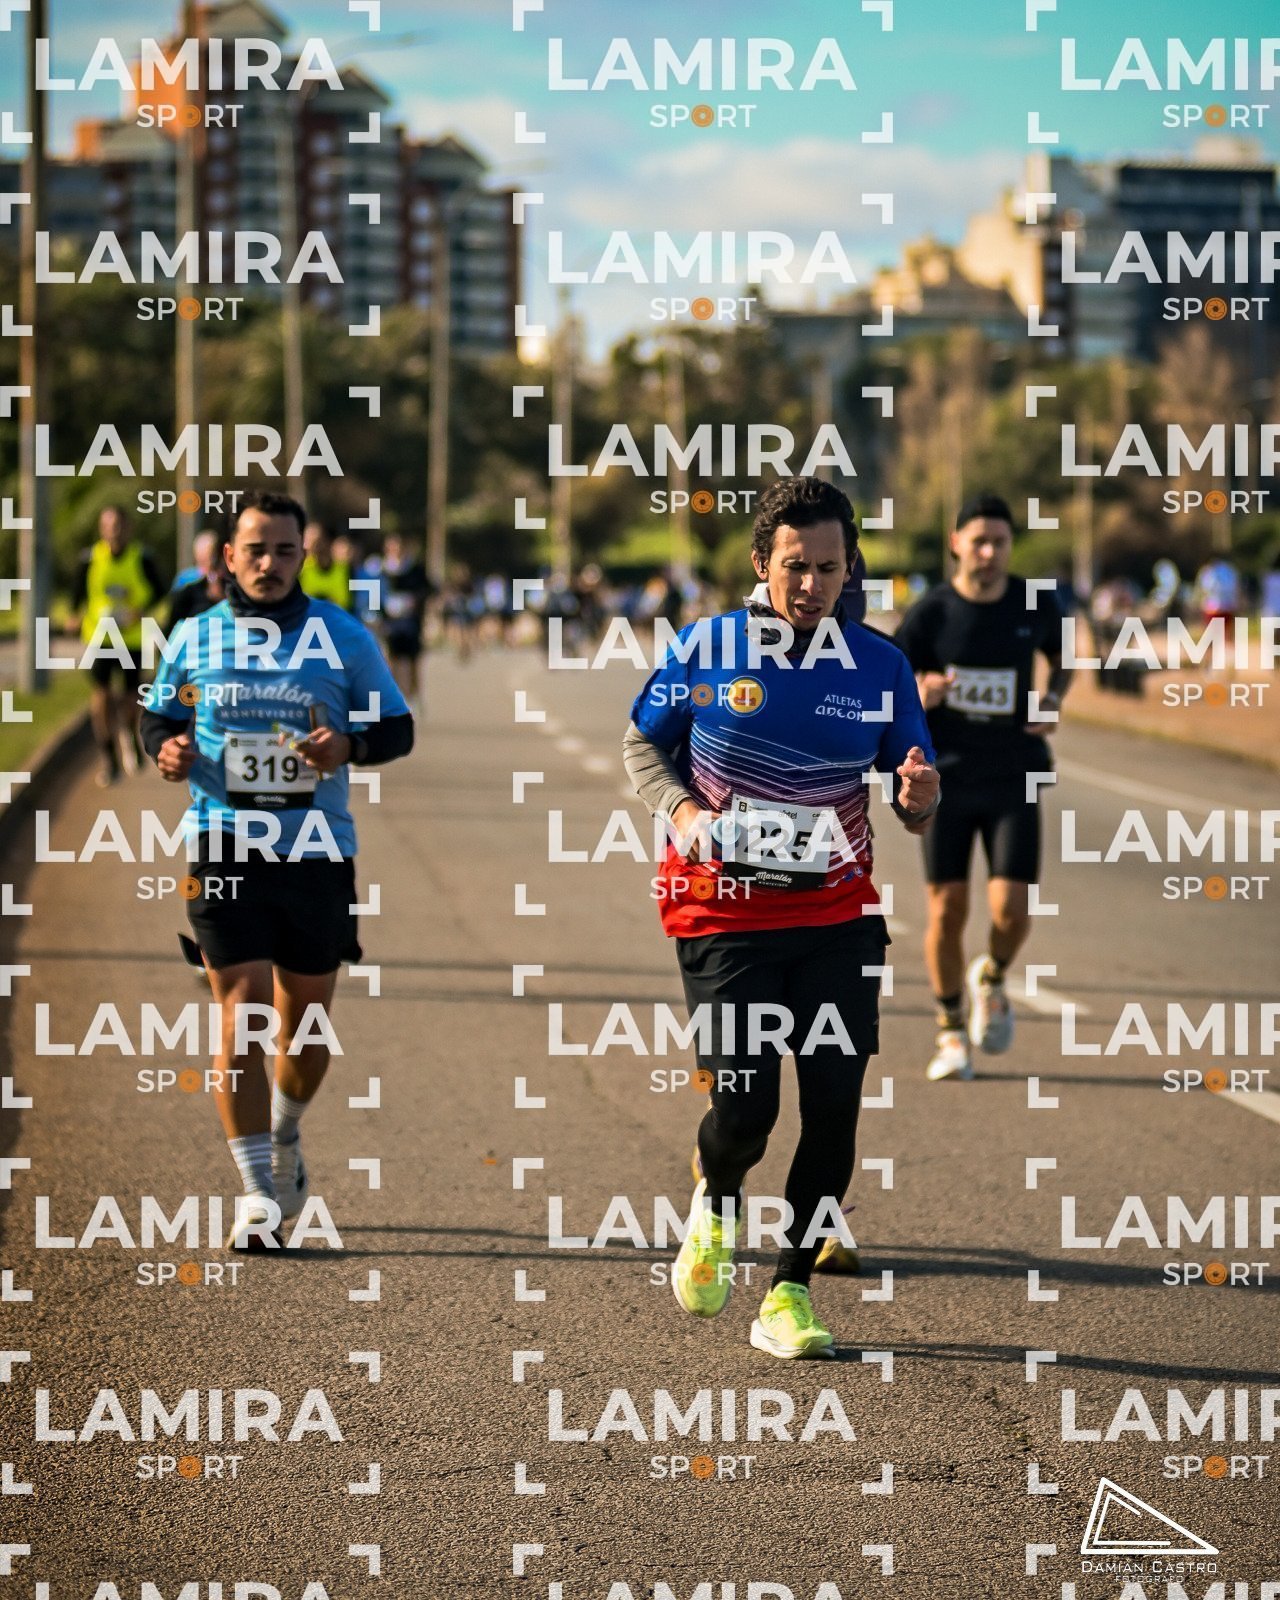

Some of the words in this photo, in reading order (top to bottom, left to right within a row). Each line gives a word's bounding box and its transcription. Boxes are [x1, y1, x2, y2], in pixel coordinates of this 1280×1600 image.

[823, 693, 862, 709] ATLETAS
[952, 684, 1008, 706] 1443
[220, 708, 304, 719] MONTEVIDEO
[241, 755, 299, 783] 319
[743, 824, 812, 862] 225
[755, 871, 793, 884] Maratón
